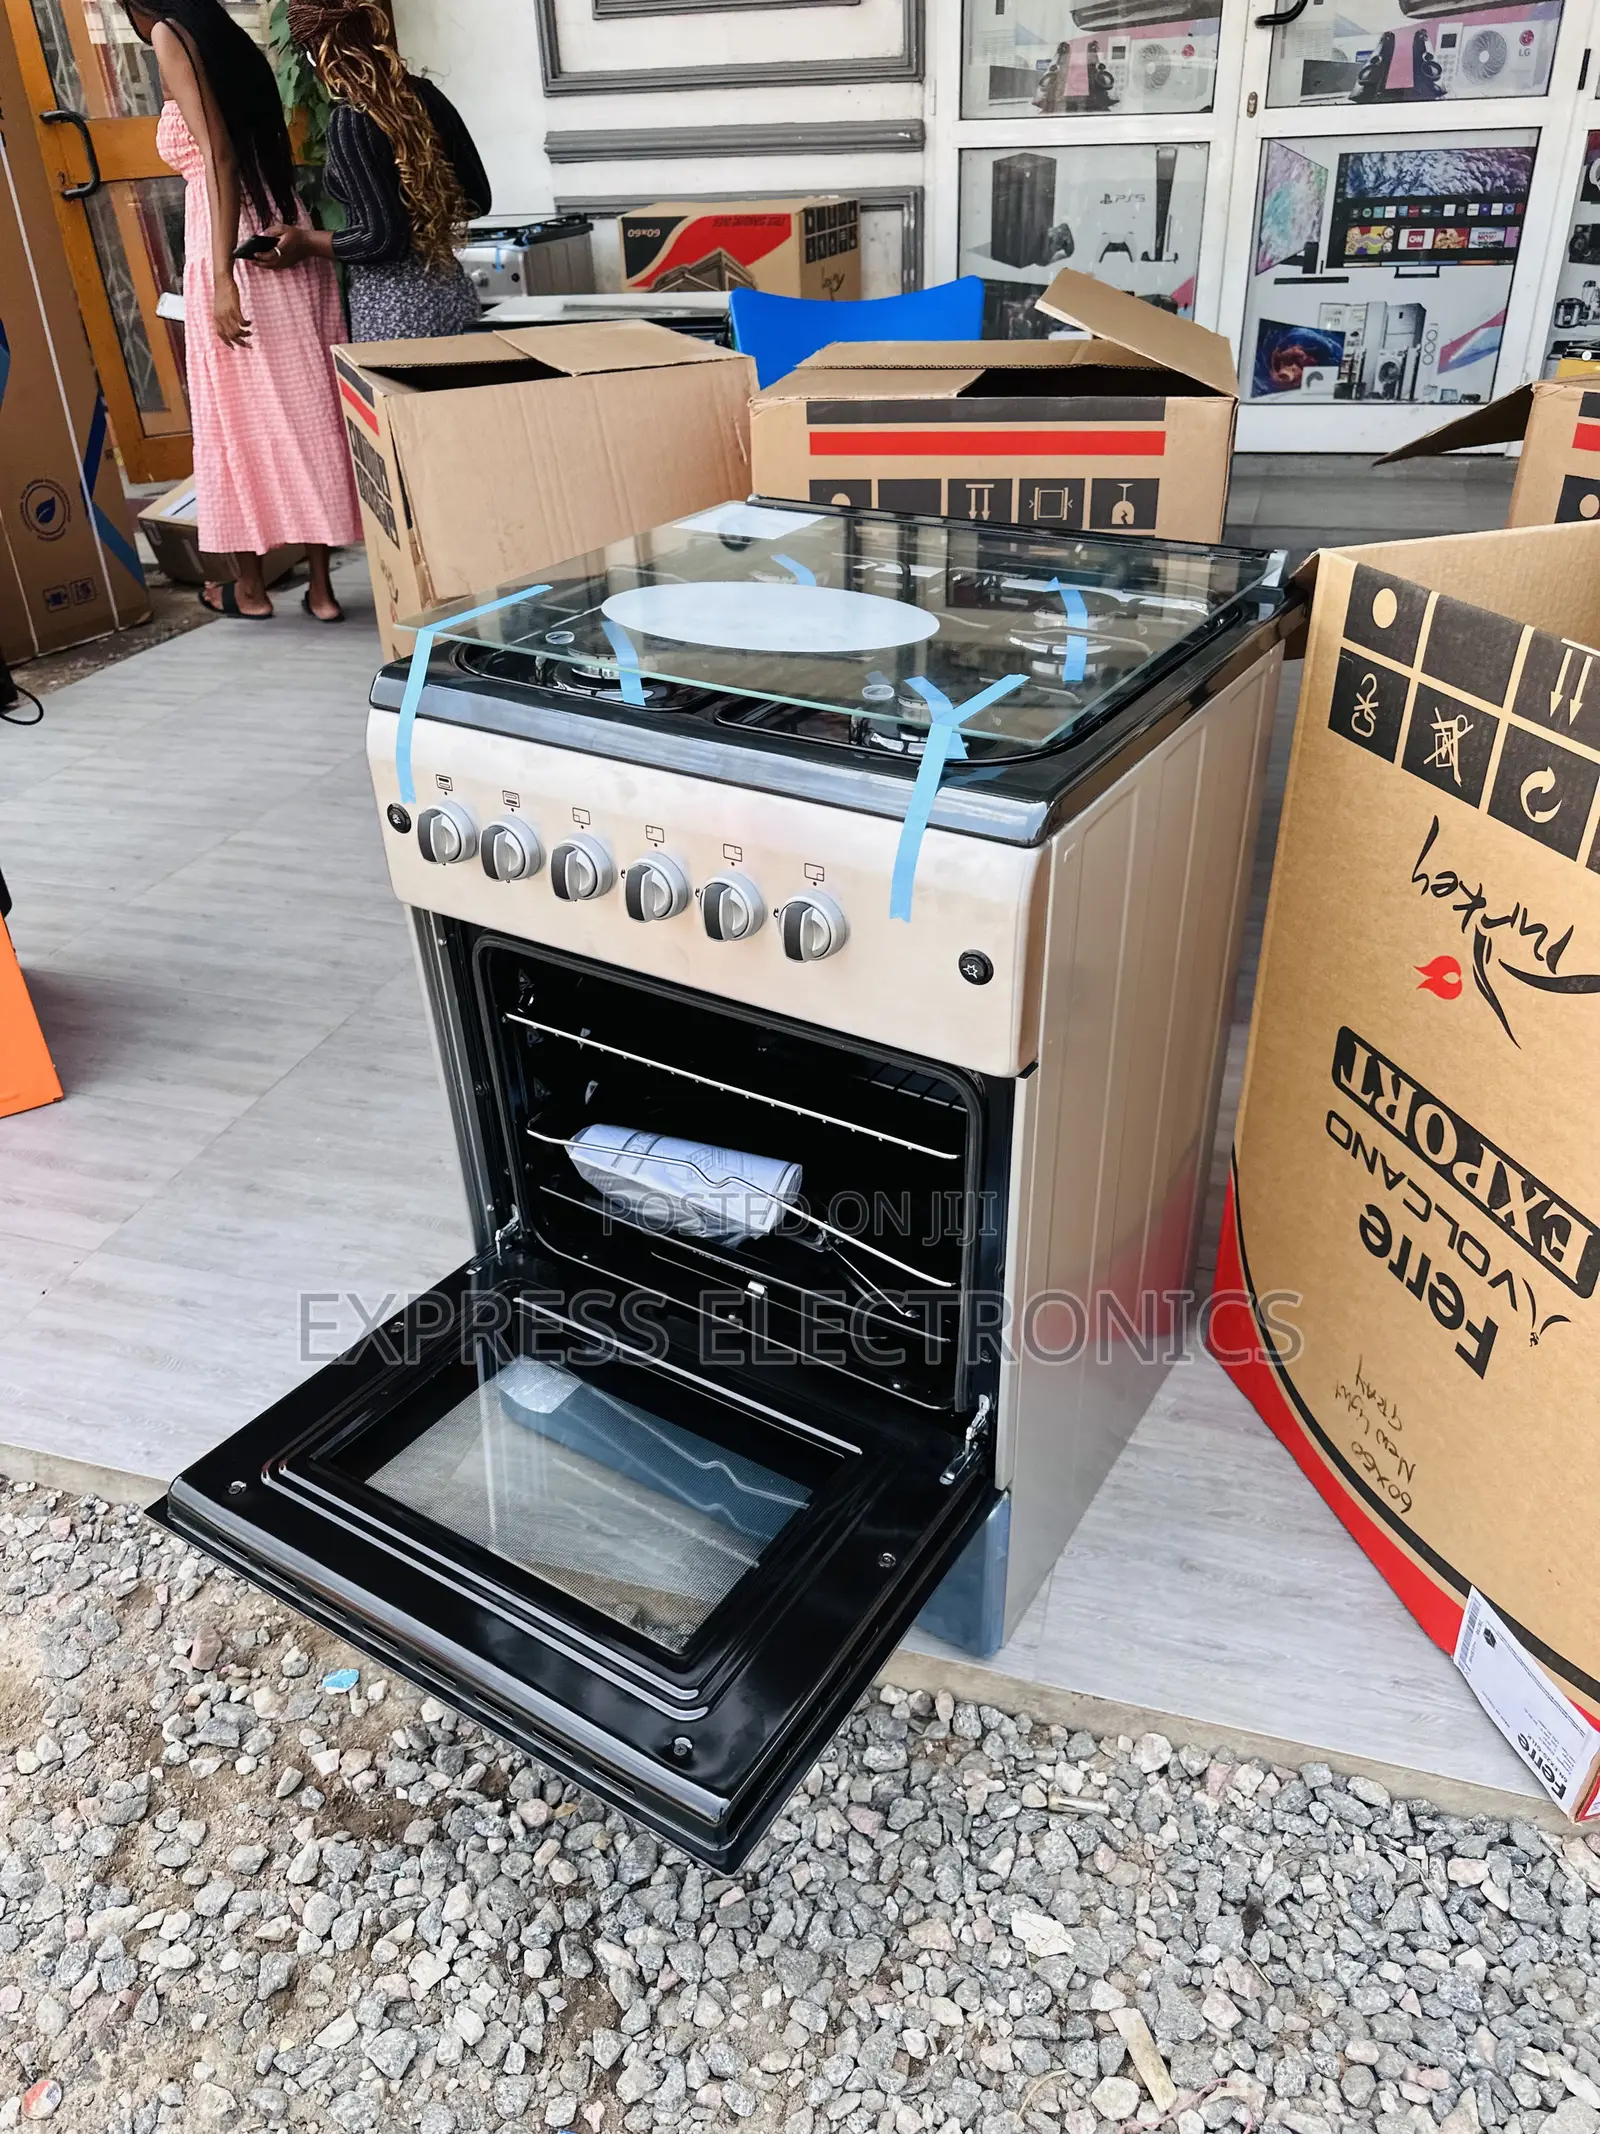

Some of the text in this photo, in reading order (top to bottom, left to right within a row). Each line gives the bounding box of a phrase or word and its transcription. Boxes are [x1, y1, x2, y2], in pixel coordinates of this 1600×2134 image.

[1518, 47, 1531, 57] LG
[626, 227, 661, 239] 60x60
[1116, 193, 1146, 204] PS5
[1411, 815, 1574, 976] Turkey
[1336, 1040, 1593, 1286] EXPORT
[1325, 1109, 1519, 1312] VOLCANO
[1357, 1202, 1499, 1380] Ferre
[1350, 1440, 1413, 1515] 60x60
[1517, 1731, 1567, 1800] Ferre
